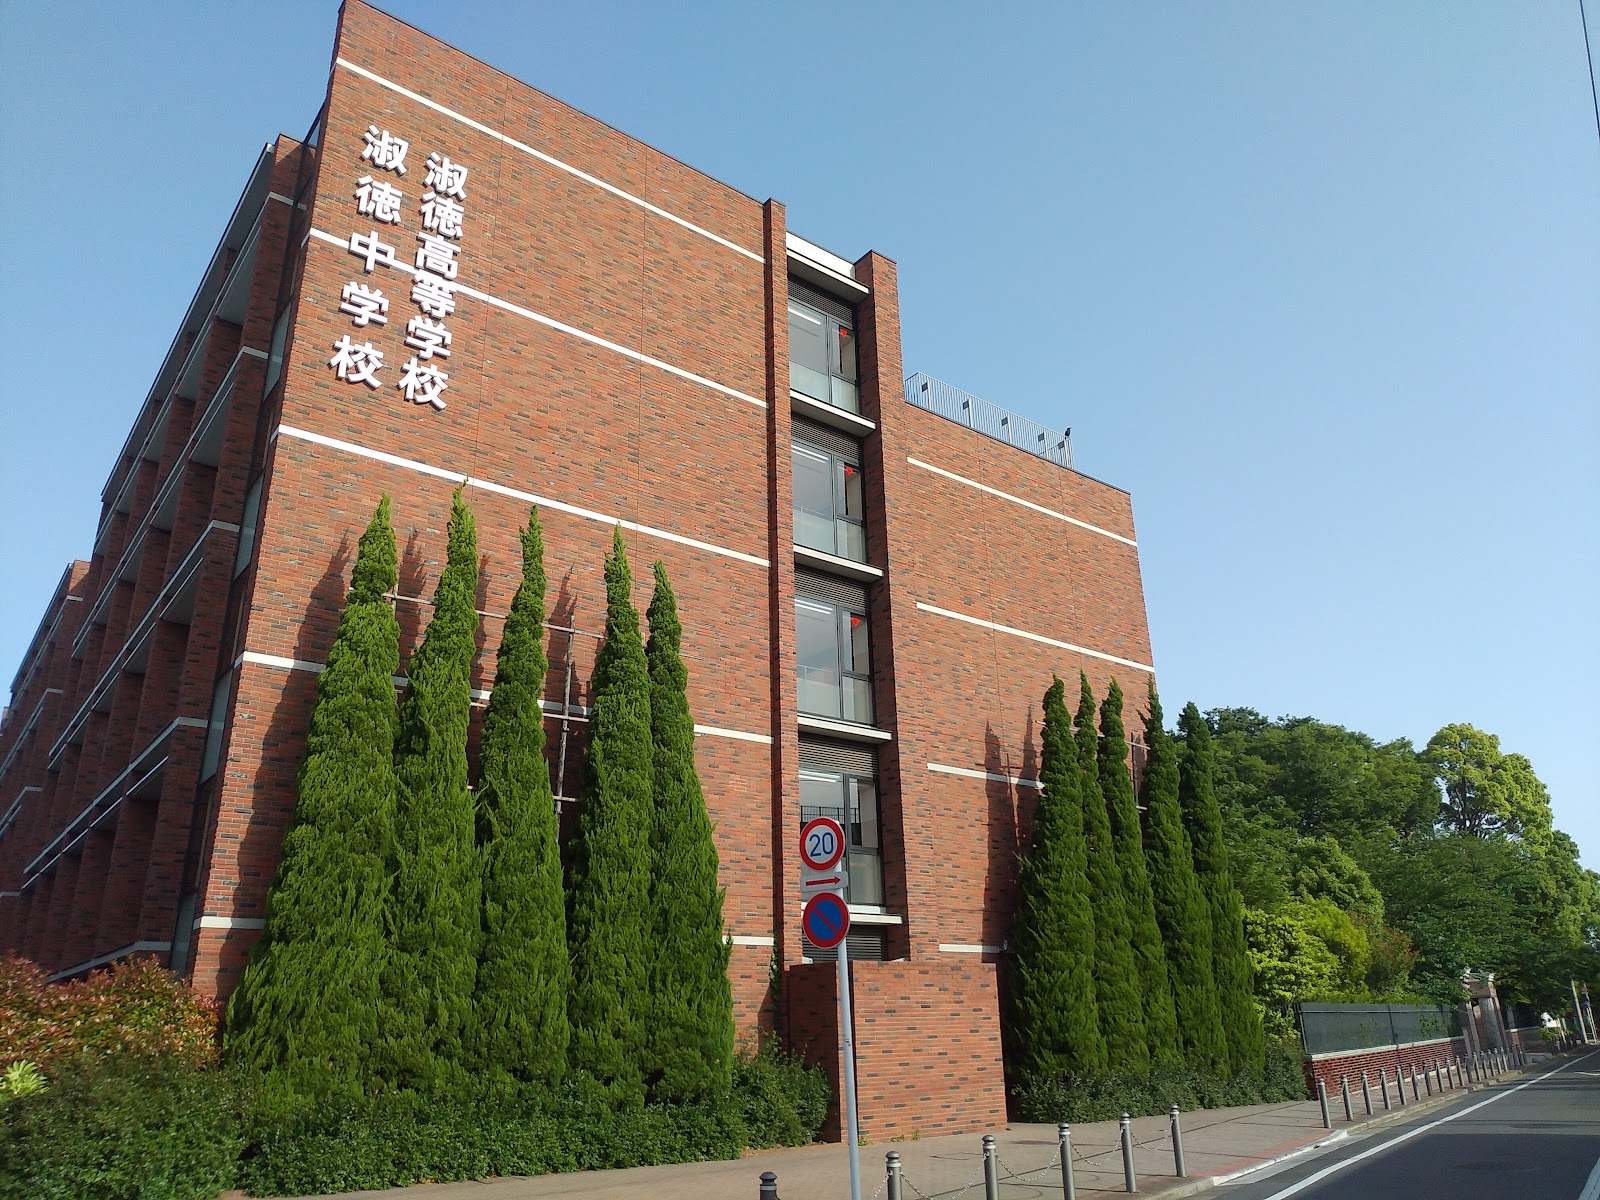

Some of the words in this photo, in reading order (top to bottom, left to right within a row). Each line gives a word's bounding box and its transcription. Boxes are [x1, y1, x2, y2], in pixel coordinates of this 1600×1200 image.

[329, 124, 409, 389] 淑徳中学校
[398, 151, 468, 411] 淑徳高等学校
[809, 832, 834, 857] 20
